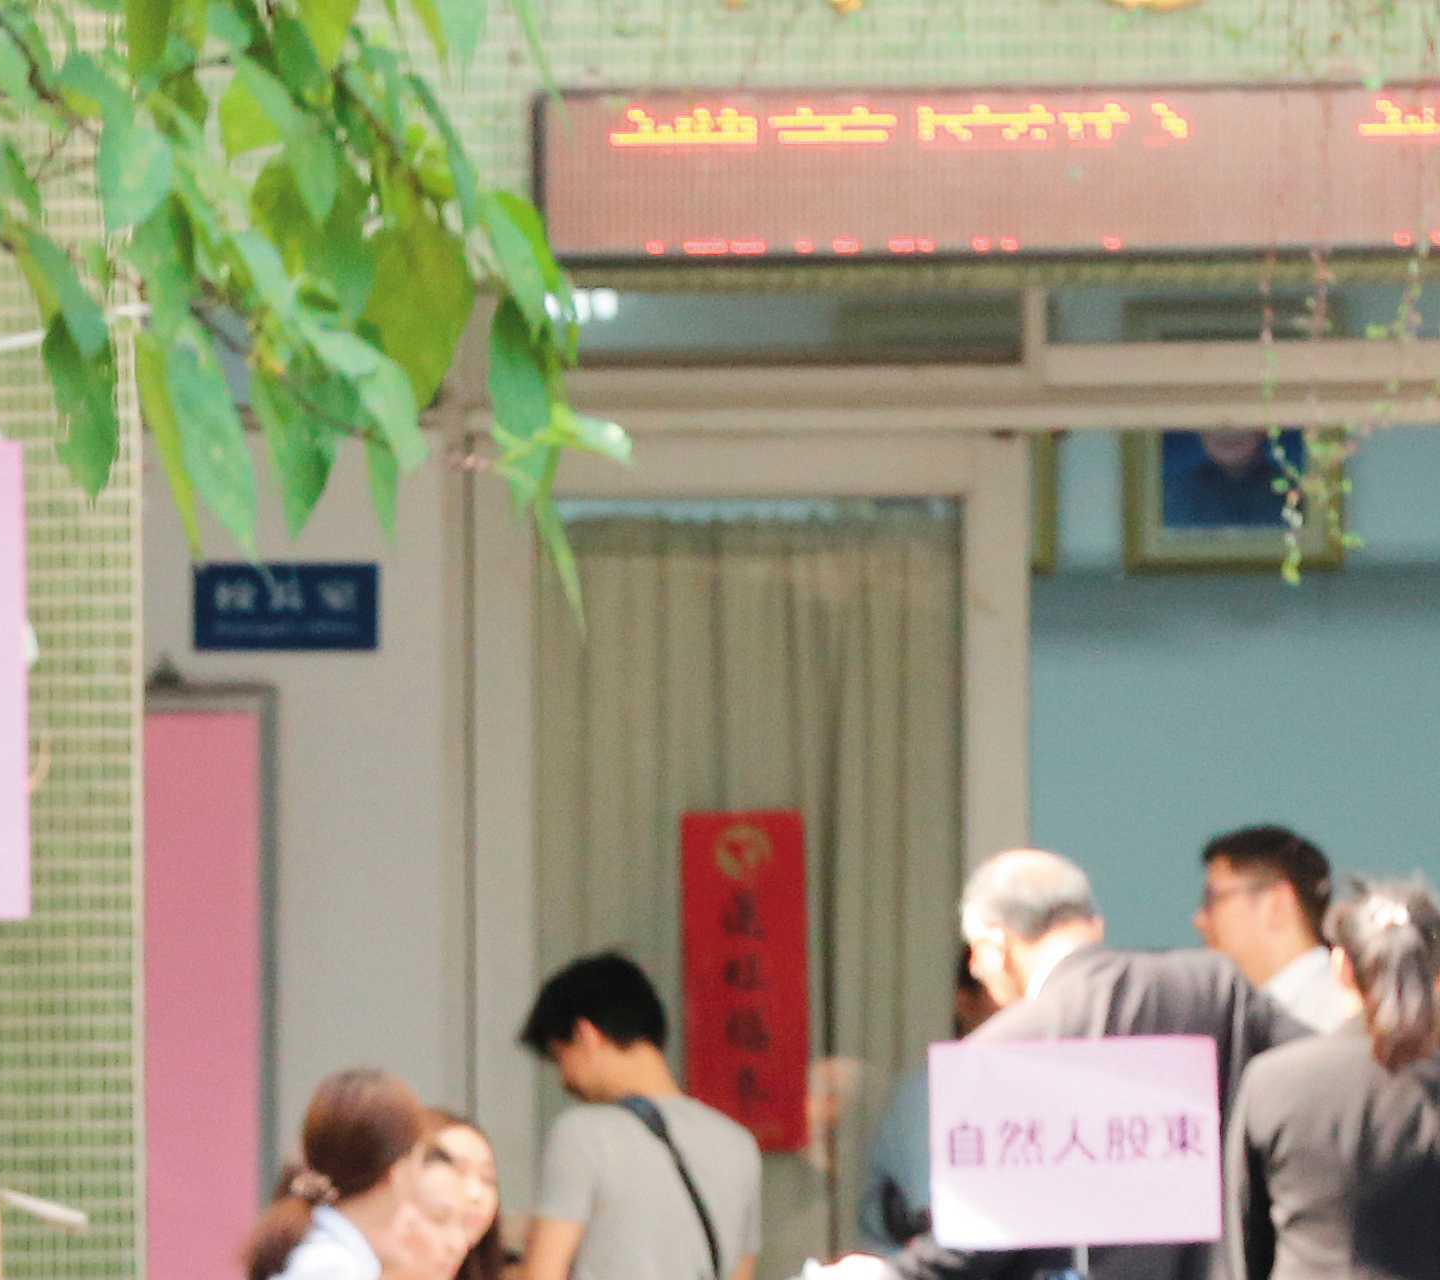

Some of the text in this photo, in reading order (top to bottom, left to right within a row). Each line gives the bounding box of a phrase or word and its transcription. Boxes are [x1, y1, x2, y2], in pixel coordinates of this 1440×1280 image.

[947, 1113, 1210, 1170] 自然人股東
